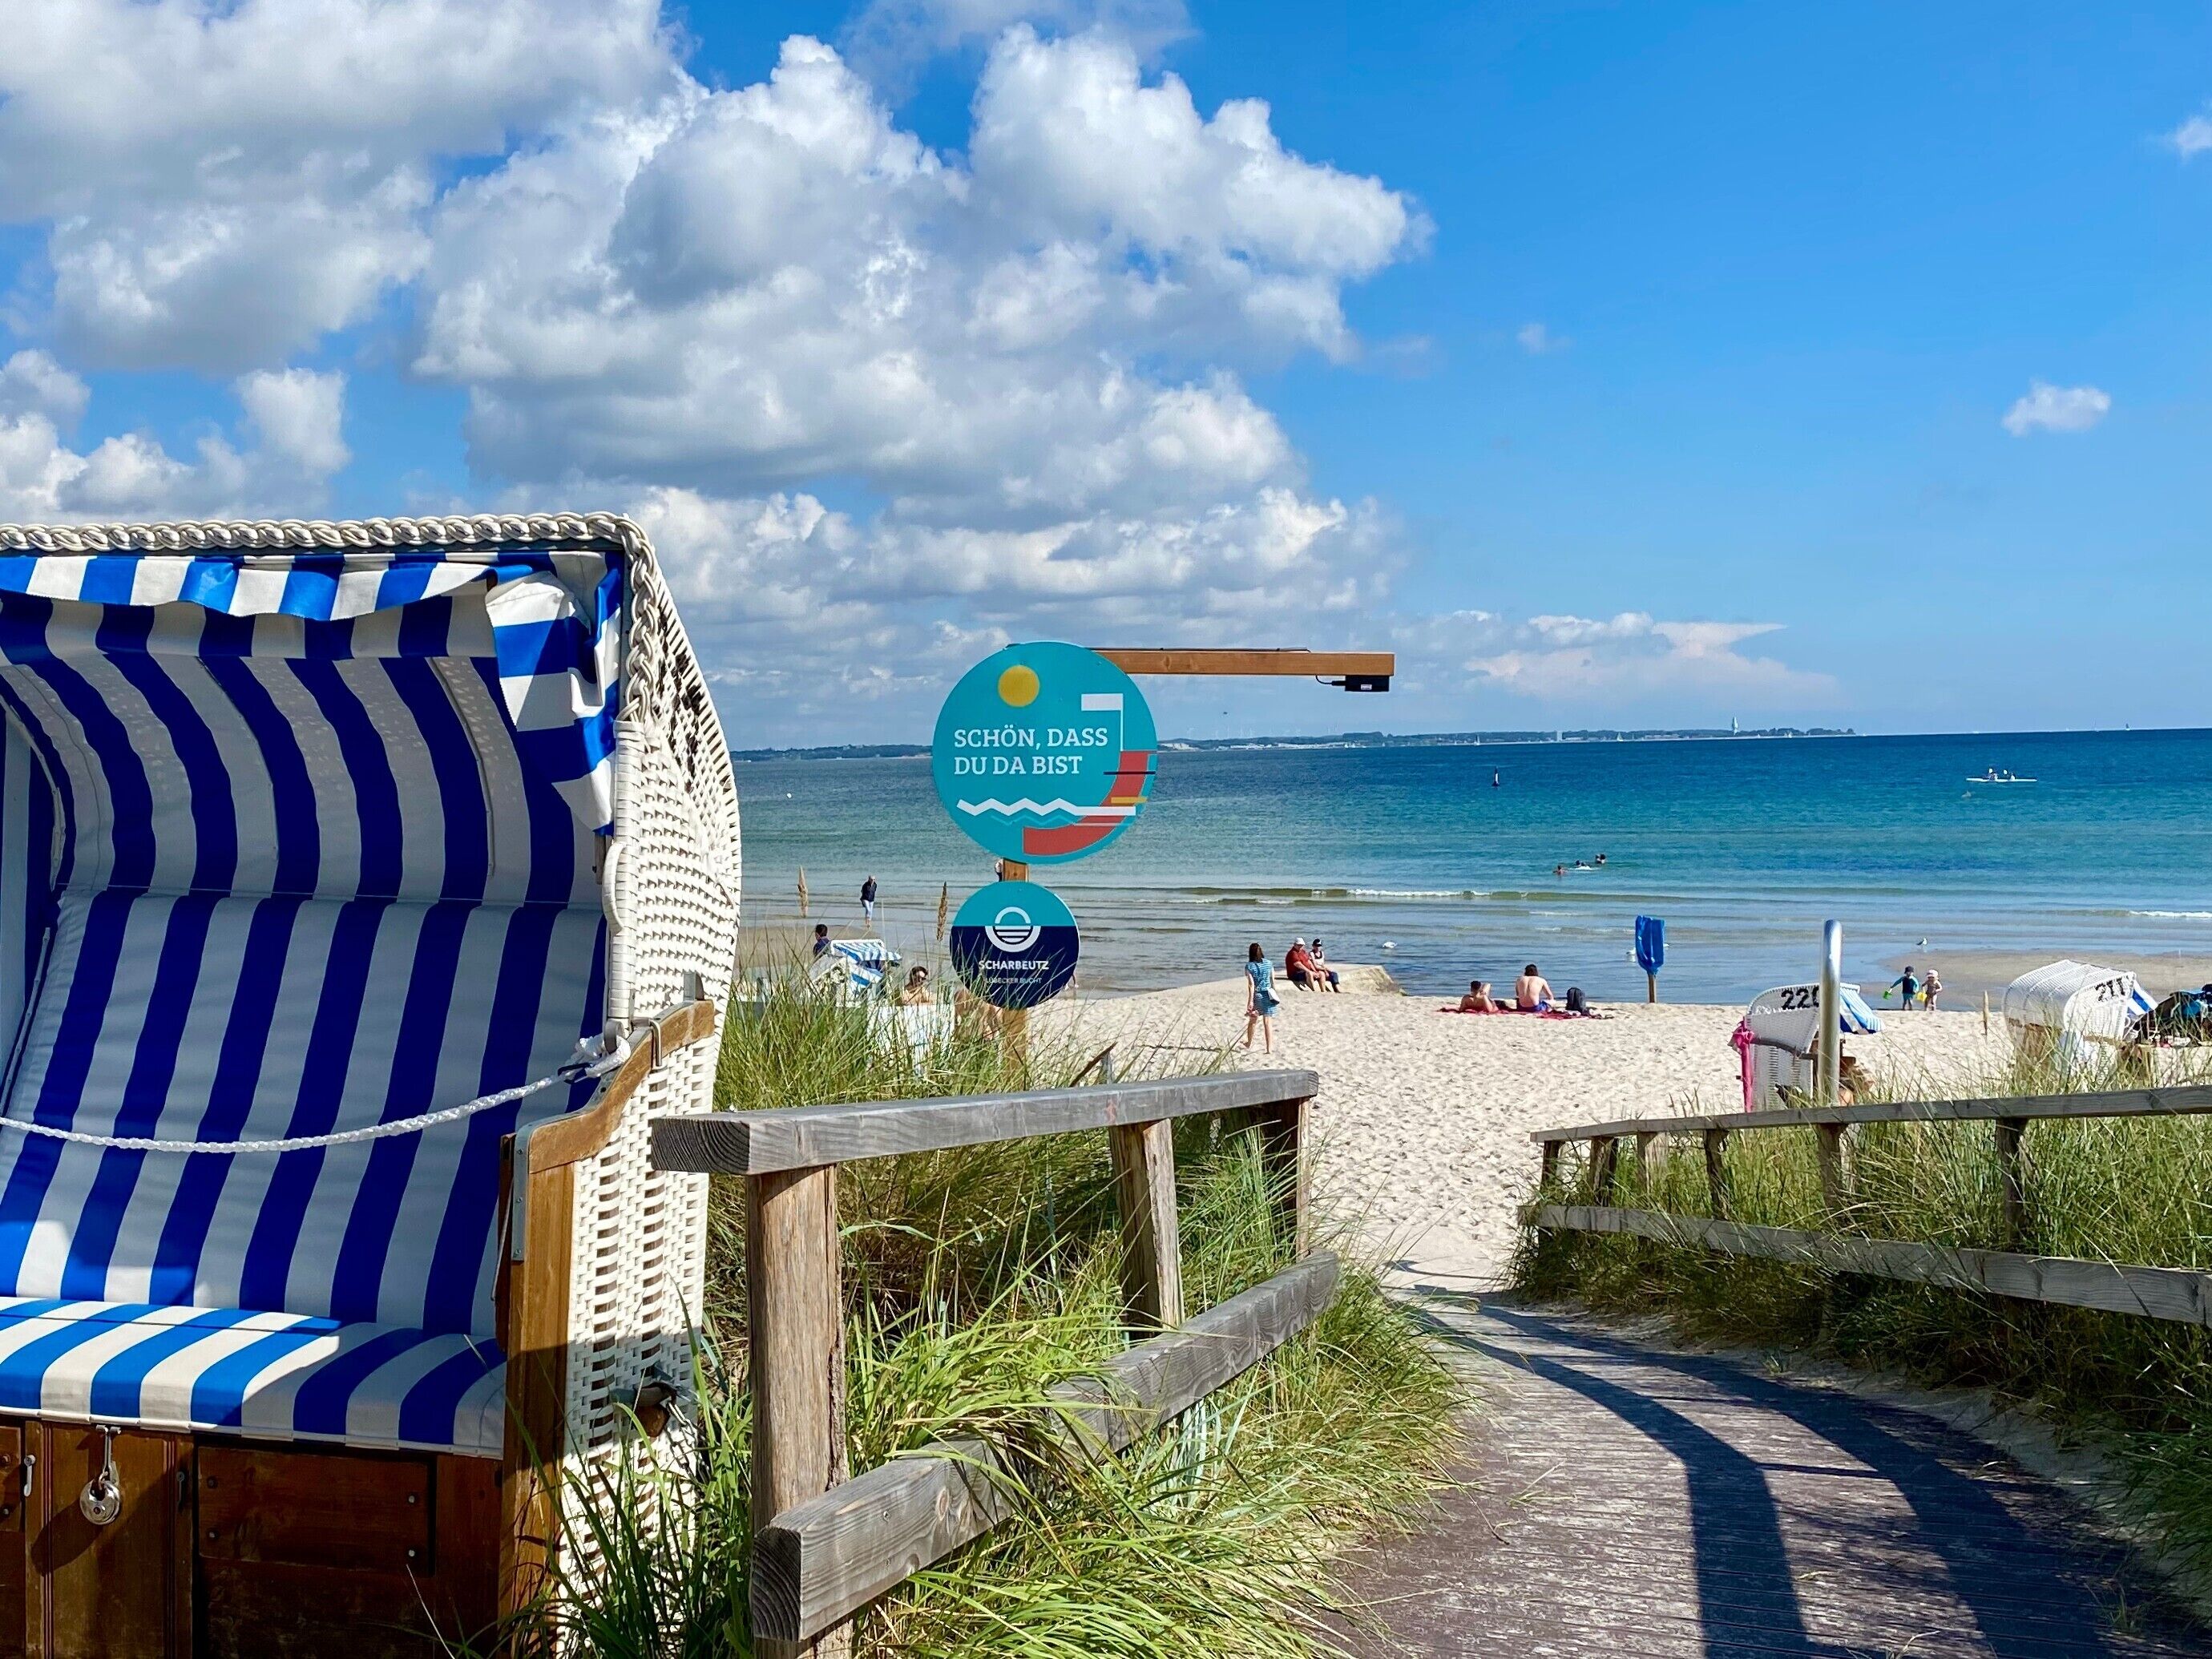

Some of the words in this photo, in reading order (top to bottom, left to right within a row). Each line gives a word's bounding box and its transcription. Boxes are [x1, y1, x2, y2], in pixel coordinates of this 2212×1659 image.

[954, 725, 1040, 750] SCHÖN,
[1047, 728, 1108, 747] DASS
[954, 756, 987, 775] DU
[993, 756, 1027, 775] DA
[1031, 756, 1083, 775] BIST
[978, 960, 1049, 970] SCHARBEUTZ
